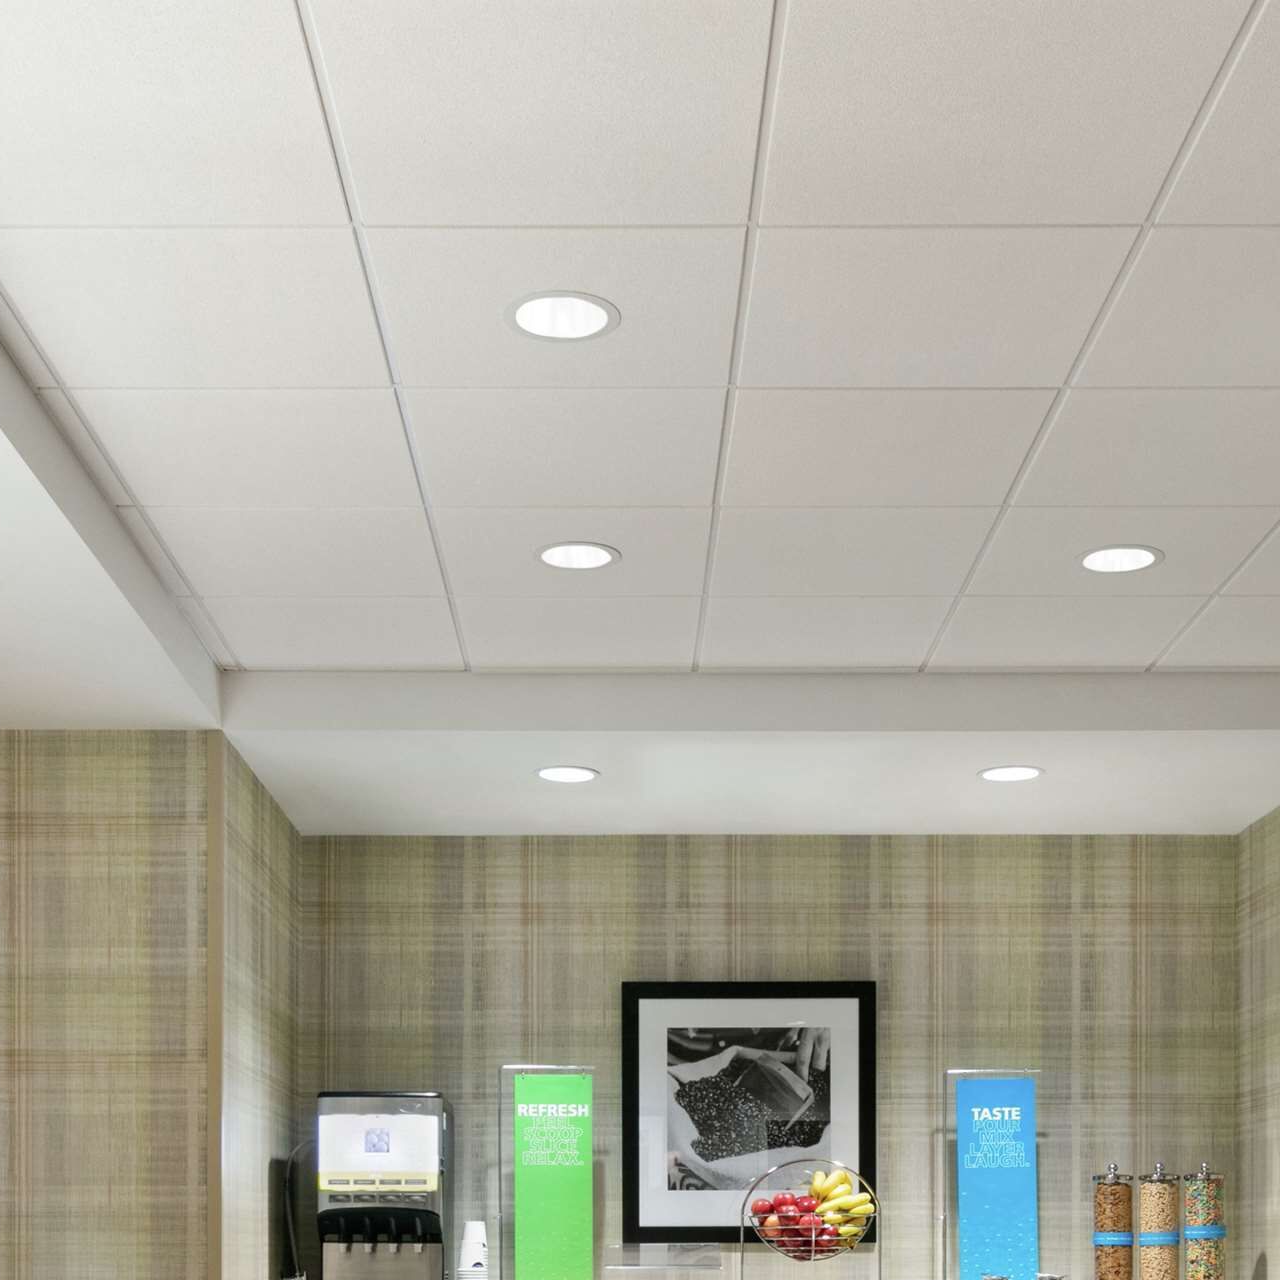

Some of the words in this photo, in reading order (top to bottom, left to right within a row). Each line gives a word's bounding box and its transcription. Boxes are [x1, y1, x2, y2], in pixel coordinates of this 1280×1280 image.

[517, 1103, 589, 1117] REFRESH
[970, 1107, 1022, 1121] TASTE
[972, 1119, 1022, 1133] POUR
[523, 1126, 584, 1141] SCOOP
[979, 1131, 1016, 1145] MIX
[969, 1142, 1025, 1157] LAYER
